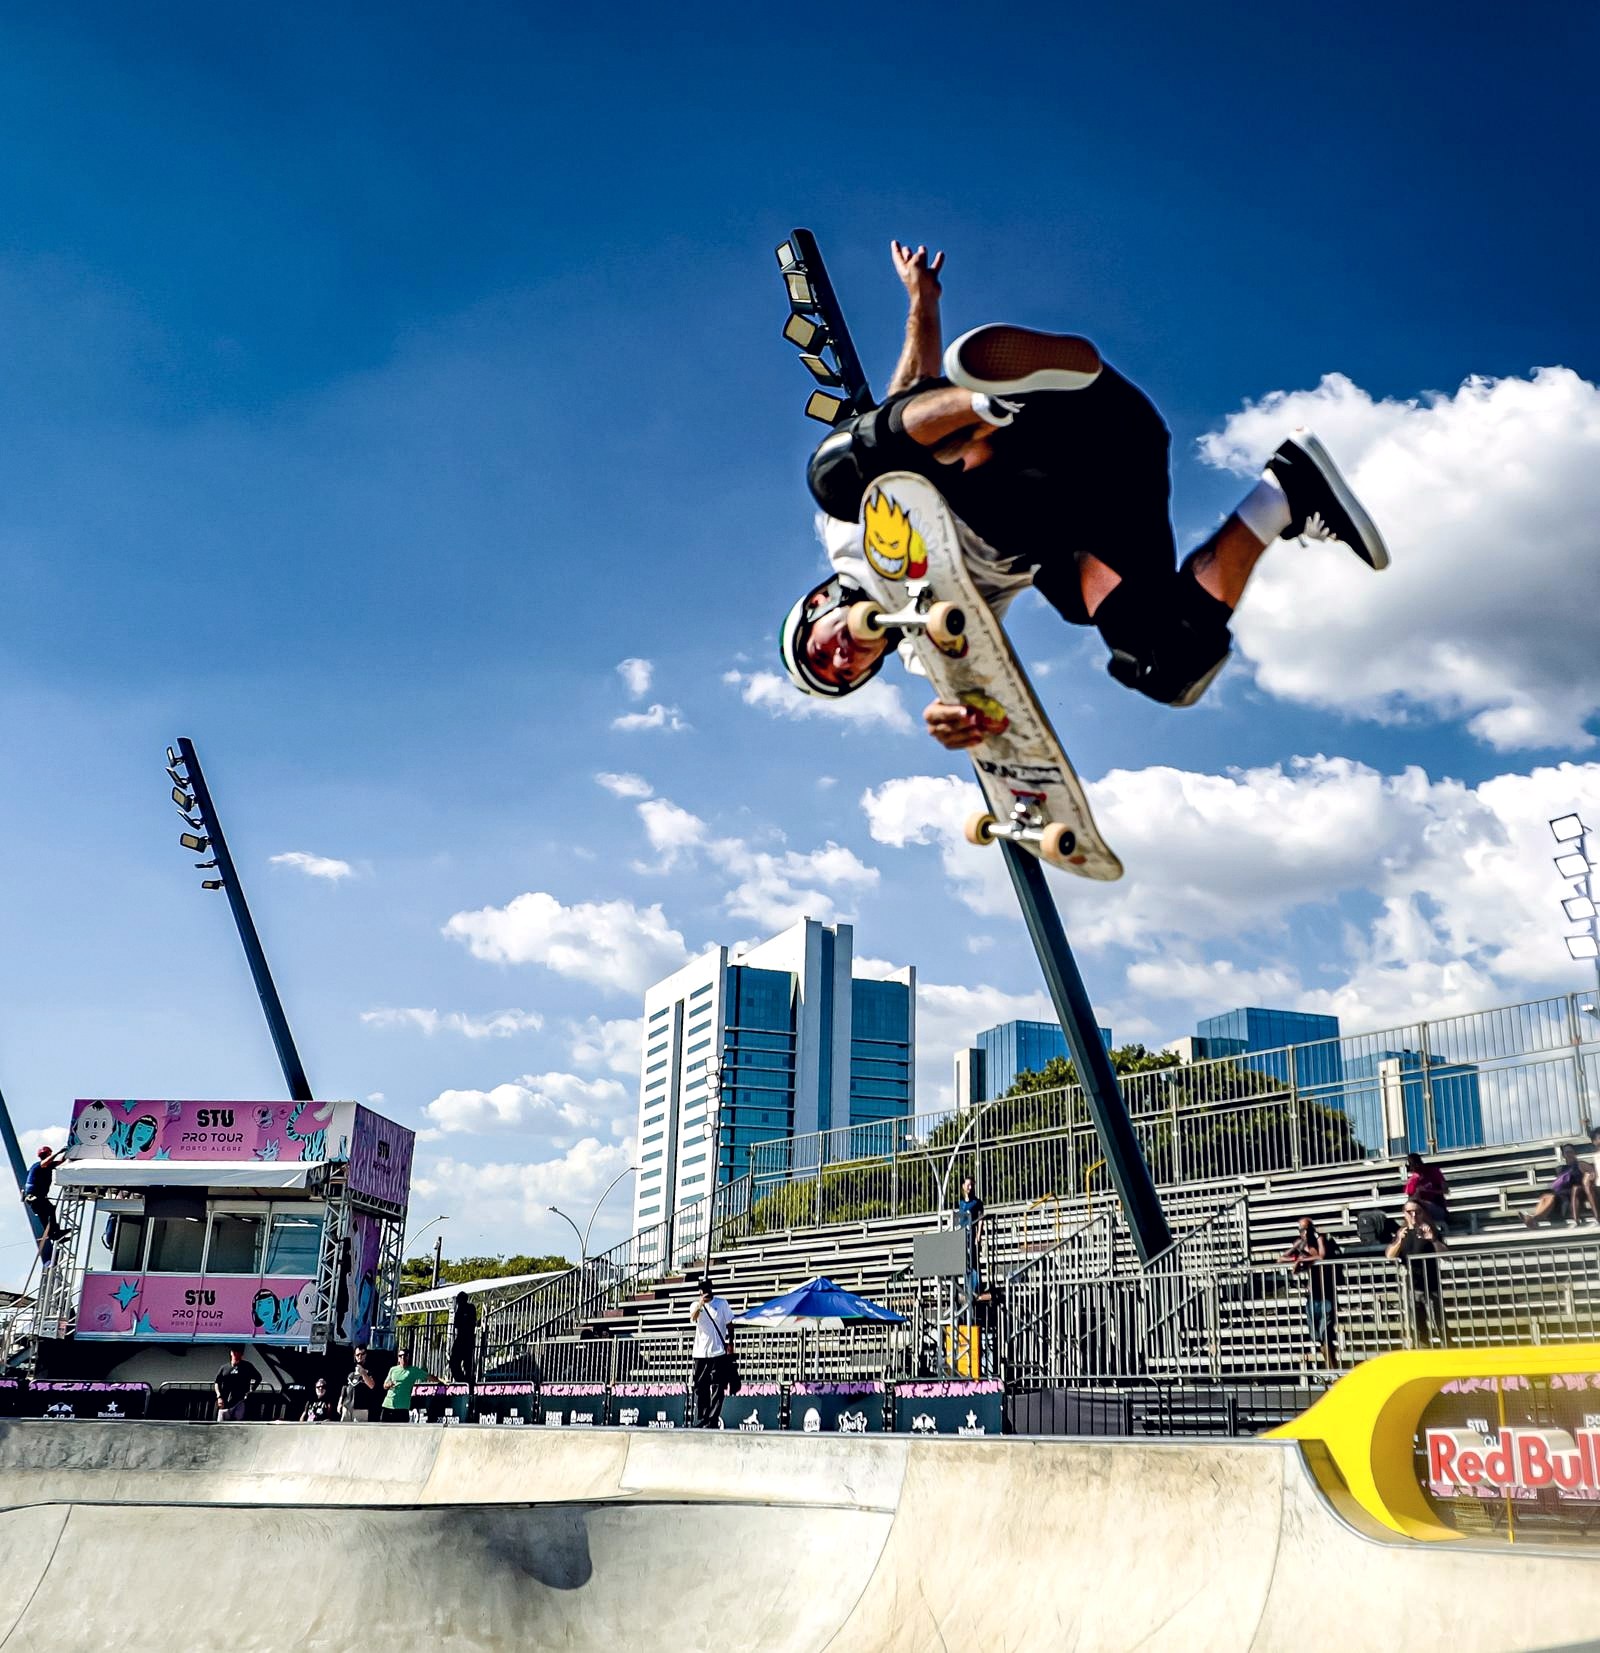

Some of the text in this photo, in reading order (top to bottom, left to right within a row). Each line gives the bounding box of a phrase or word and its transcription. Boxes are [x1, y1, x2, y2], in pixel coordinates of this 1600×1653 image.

[197, 1109, 234, 1127] STU
[182, 1133, 243, 1142] PRO TOUR
[185, 1289, 216, 1305] STU
[172, 1310, 223, 1318] PRO TOUR
[1467, 1419, 1489, 1432] STU
[1428, 1431, 1600, 1487] Red Bull
